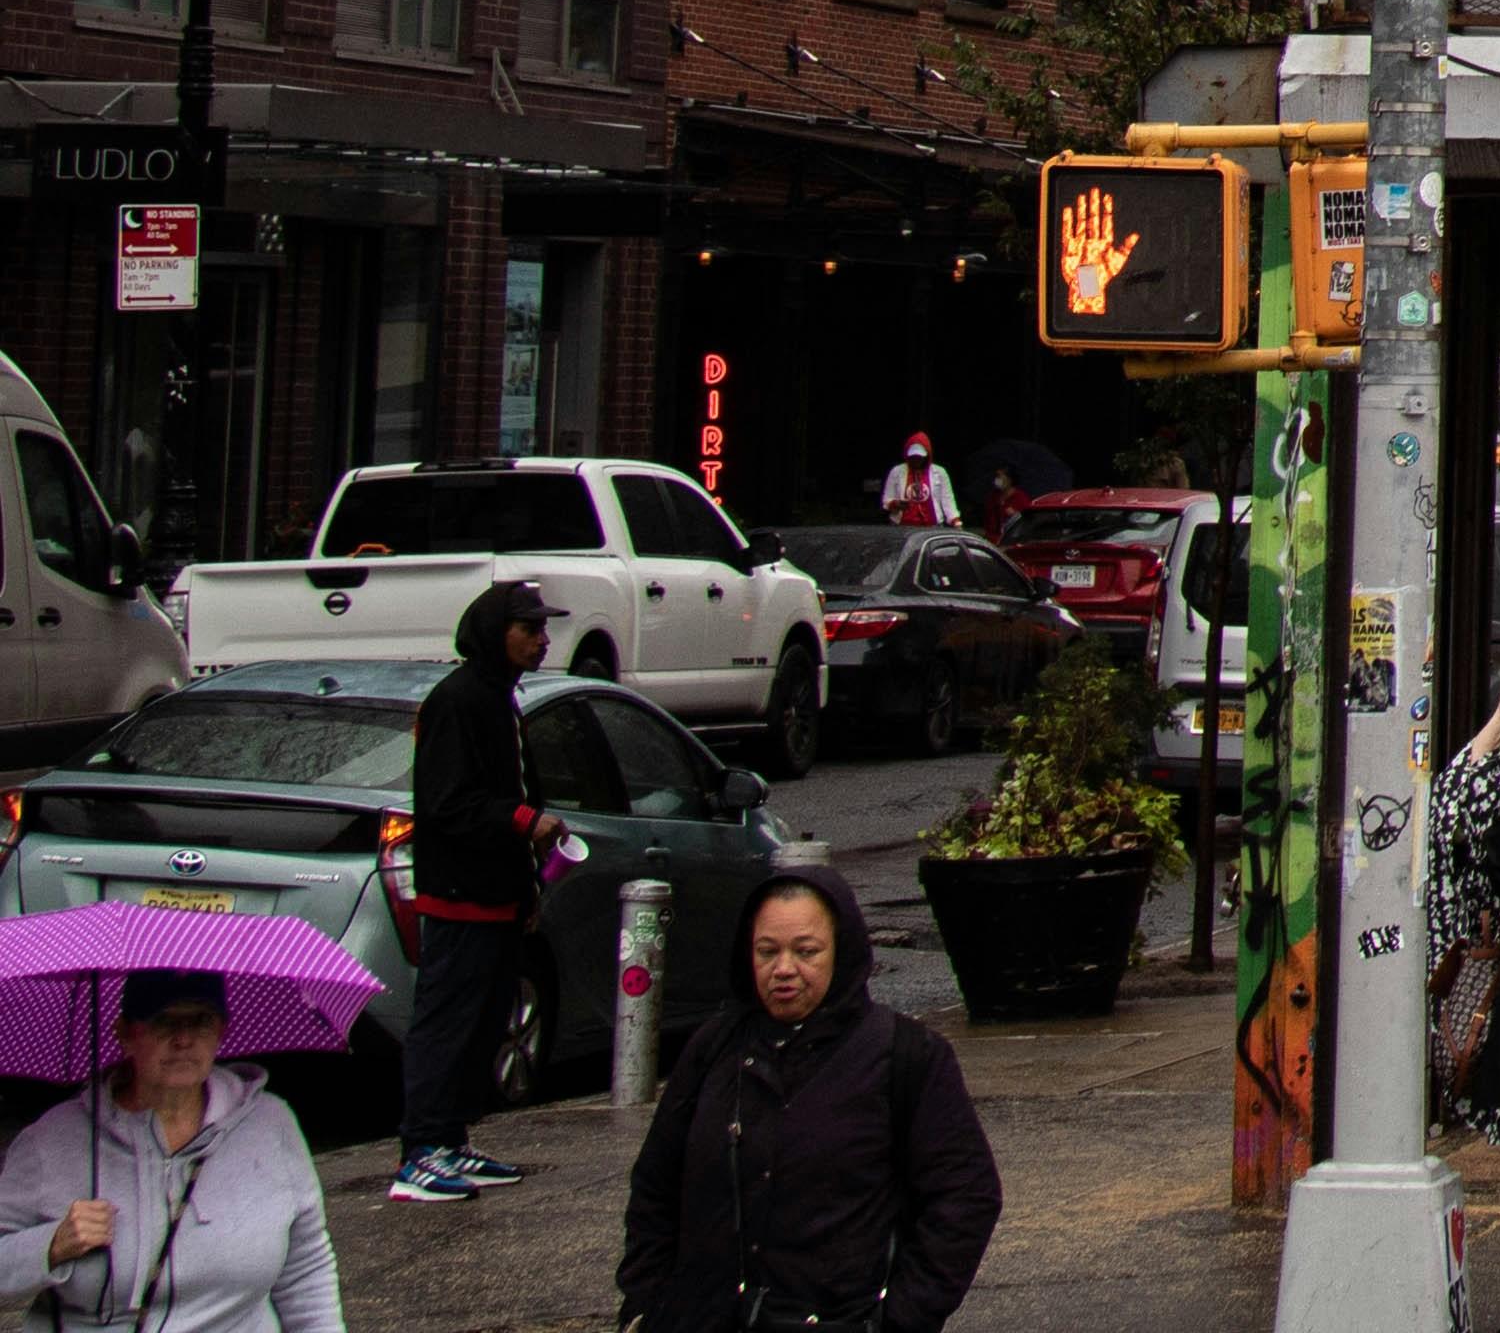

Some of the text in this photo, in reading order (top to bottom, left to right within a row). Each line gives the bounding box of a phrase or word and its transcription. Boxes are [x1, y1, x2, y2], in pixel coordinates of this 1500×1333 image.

[56, 147, 212, 182] LUDLO
[1324, 192, 1366, 208] NOMA
[146, 210, 195, 219] NO STANDING
[124, 260, 179, 270] NO PARKING
[701, 354, 727, 505] DIRT
